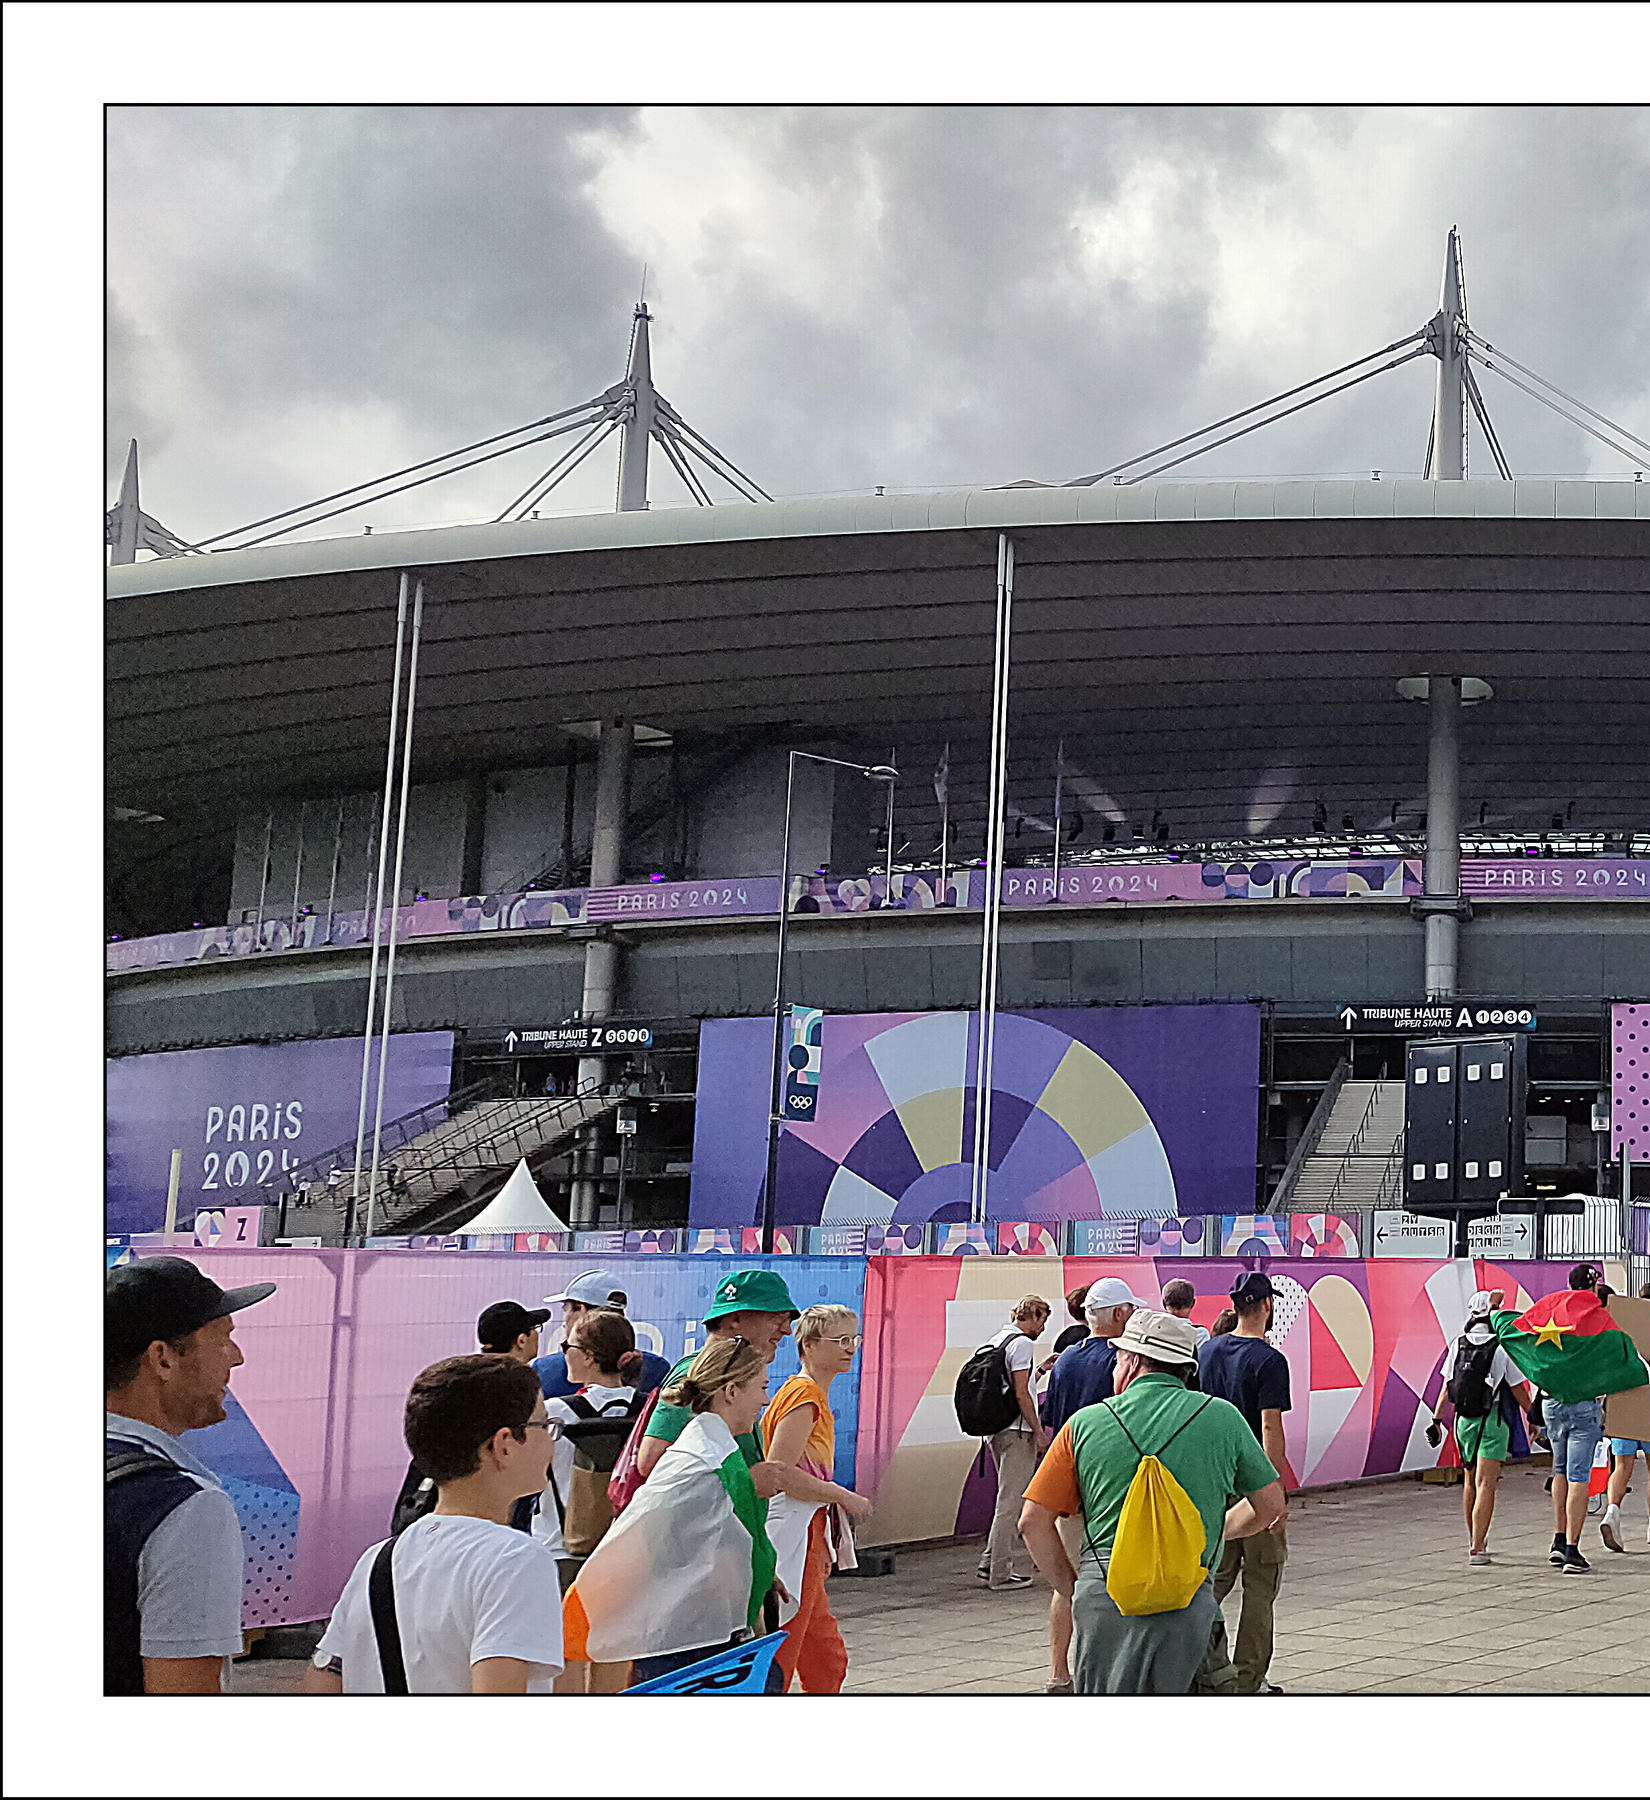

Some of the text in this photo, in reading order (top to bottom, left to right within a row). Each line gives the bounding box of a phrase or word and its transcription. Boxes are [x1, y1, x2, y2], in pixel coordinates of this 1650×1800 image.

[1092, 874, 1158, 893] 2024
[1575, 869, 1646, 887] 2024
[689, 888, 747, 908] 2024
[1362, 1008, 1411, 1019] TRIBUNE
[1414, 1008, 1452, 1018] HAUTE
[1456, 1008, 1473, 1028] A
[1394, 1019, 1452, 1028] UPPER STAND
[521, 1030, 557, 1042] TRIBUNE
[558, 1029, 588, 1040] HAUTE
[591, 1028, 603, 1047] Z
[544, 1040, 588, 1049] UPPER STAND
[201, 1149, 300, 1190] 2024
[236, 1218, 247, 1241] Z
[1088, 1241, 1123, 1254] 2024
